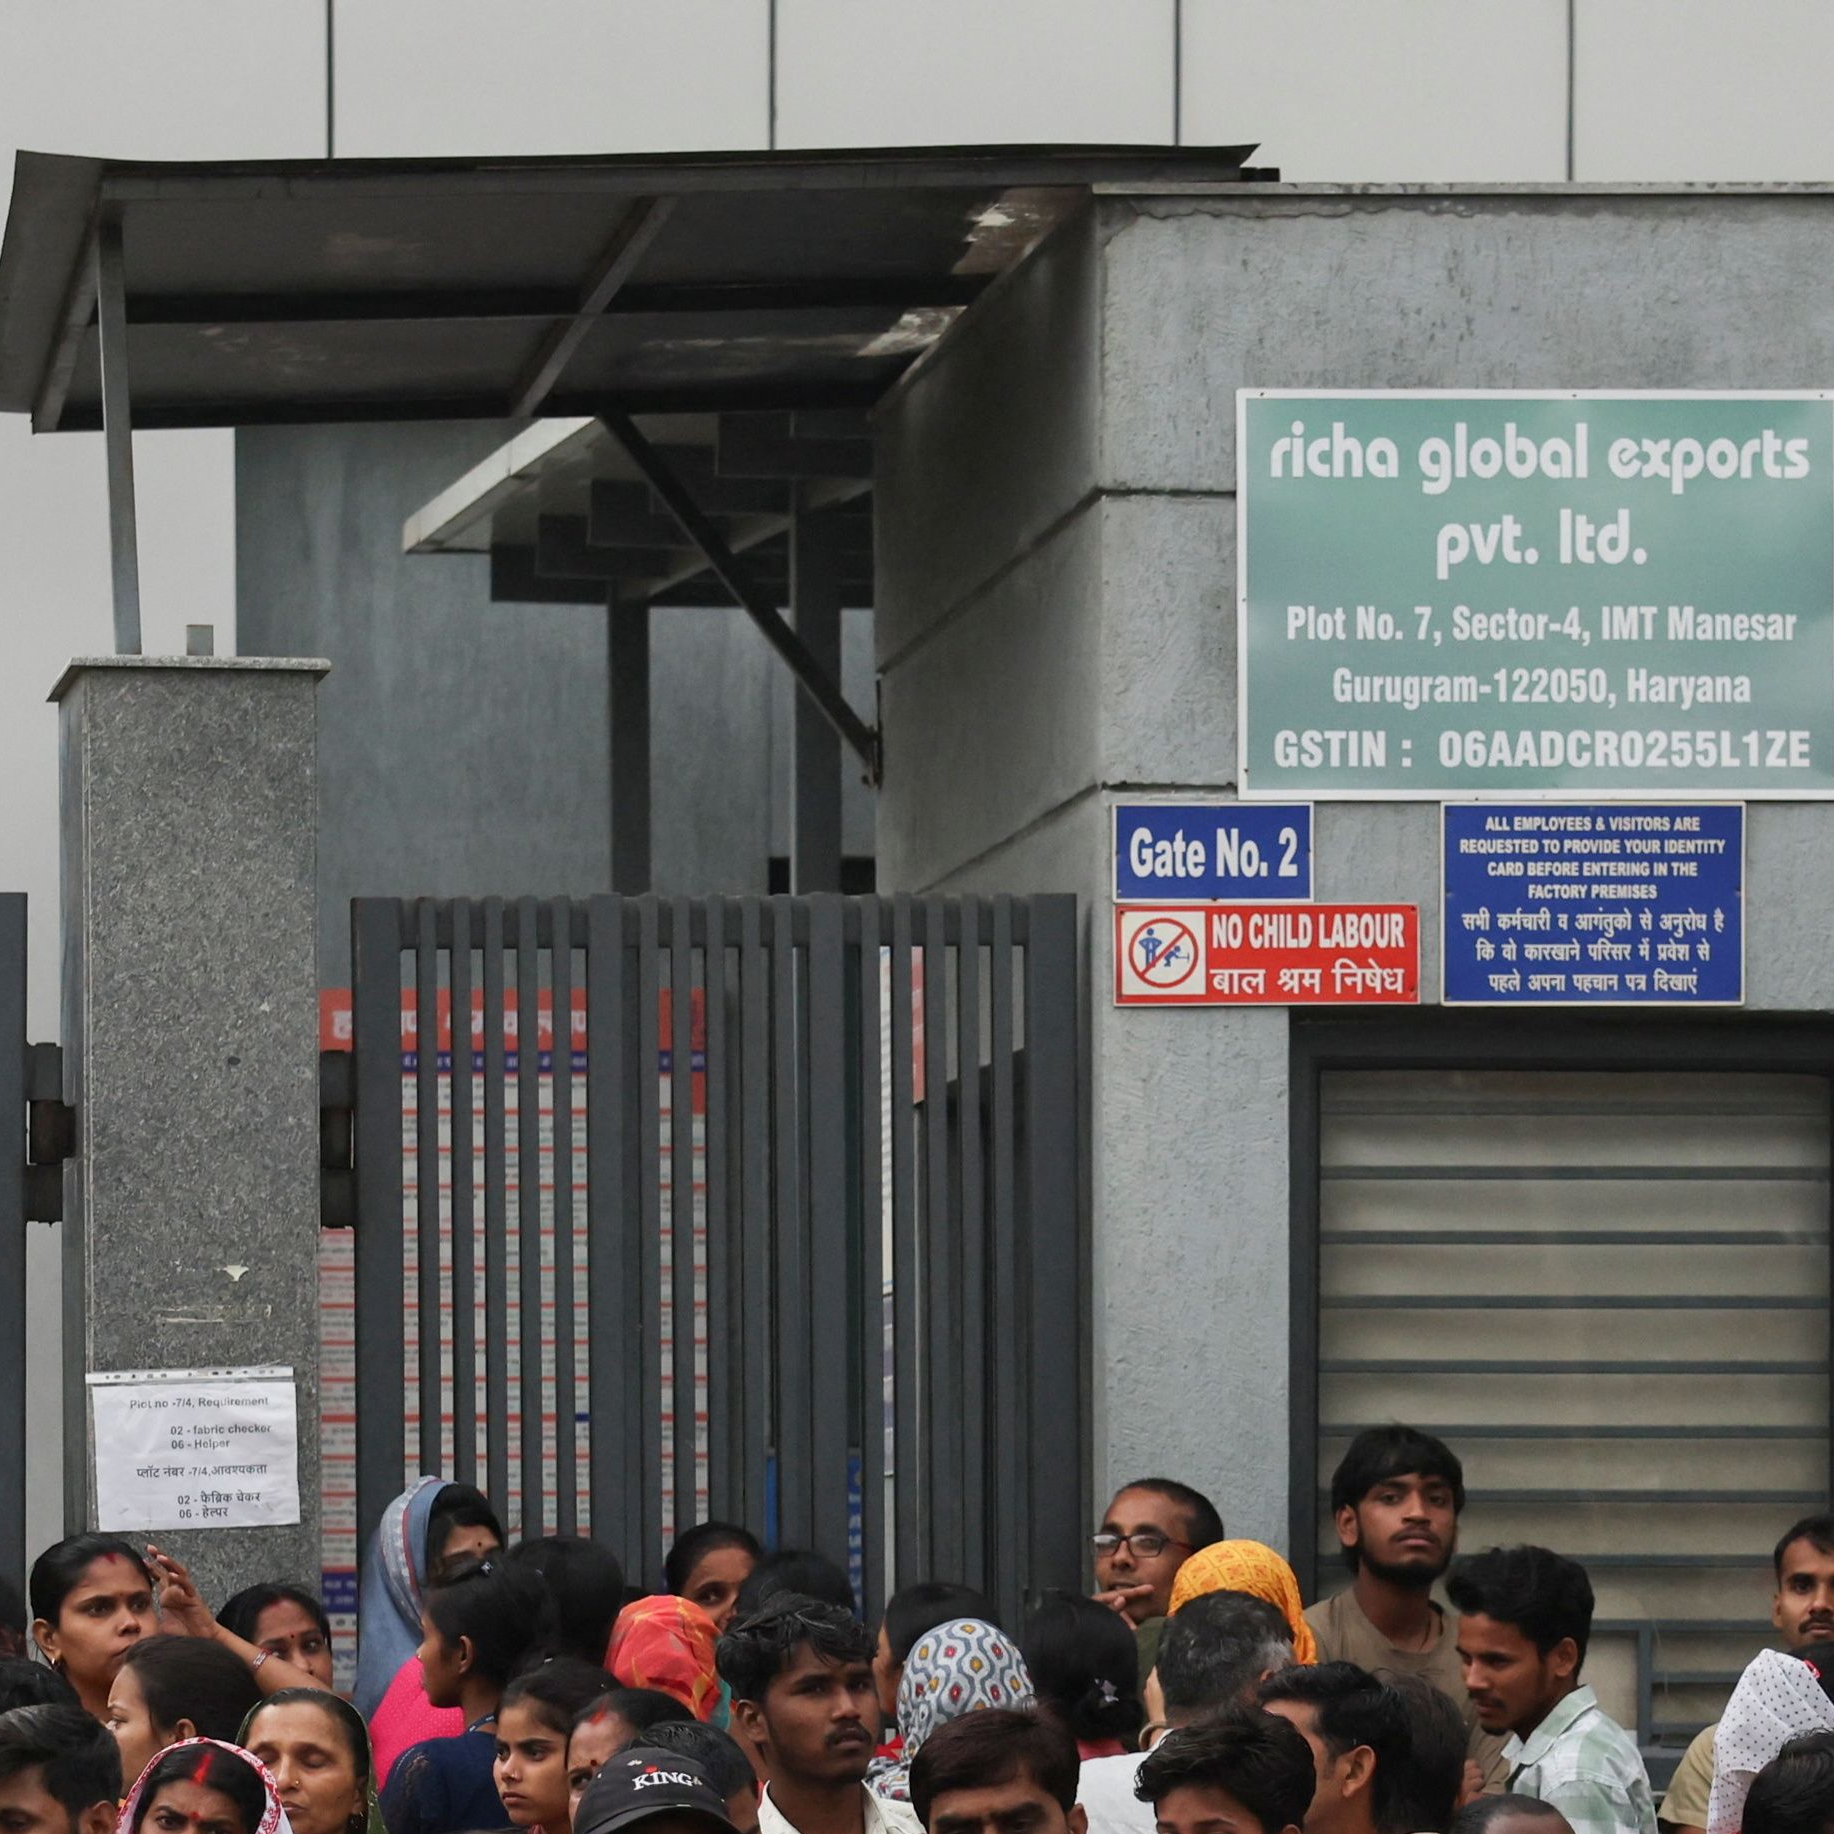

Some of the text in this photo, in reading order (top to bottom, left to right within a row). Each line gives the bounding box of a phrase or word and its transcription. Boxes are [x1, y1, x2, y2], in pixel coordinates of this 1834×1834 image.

[1271, 421, 1809, 494] richa global exports
[1437, 509, 1647, 579] pvt. ltd.
[1288, 606, 1796, 646] Plot No. 7, Sector-4, IMT Manesar
[1334, 668, 1750, 710] Gurugram-122050, Haryana
[1275, 730, 1809, 767] GSTIN : 06AADCR0255L1ZE
[1486, 817, 1700, 831] ALL EMPLOYEES & VISITORS ARE
[1130, 827, 1297, 877] Gate No. 2
[1460, 839, 1725, 853] REQUESTED TO PROVIDE YOUR IDENTITY
[1488, 862, 1697, 876] CARD BEFORE ENTERING IN THE
[1528, 884, 1657, 899] FACTORY PREMISES
[1213, 913, 1404, 948] NO CHILD LABOUR
[1462, 907, 1490, 930] सभी
[1497, 907, 1551, 930] कर्मचारी
[1557, 914, 1568, 930] व
[1639, 908, 1652, 930] से
[1660, 908, 1707, 938] अनुरोध
[1714, 908, 1724, 932] है
[1476, 938, 1710, 961] कि वो कारखाने परिसर में प्रवेश से
[1210, 958, 1404, 994] बाल श्रम निषेध
[1488, 969, 1520, 993] पहले
[1528, 975, 1565, 991] अपना
[1573, 975, 1618, 992] पहचान
[1625, 975, 1646, 991] पत्र
[171, 1426, 183, 1435] 02
[194, 1425, 224, 1434] fabric
[171, 1440, 184, 1449] 06
[178, 1495, 190, 1504] 02
[179, 1509, 192, 1518] 06
[631, 1771, 694, 1791] KING
